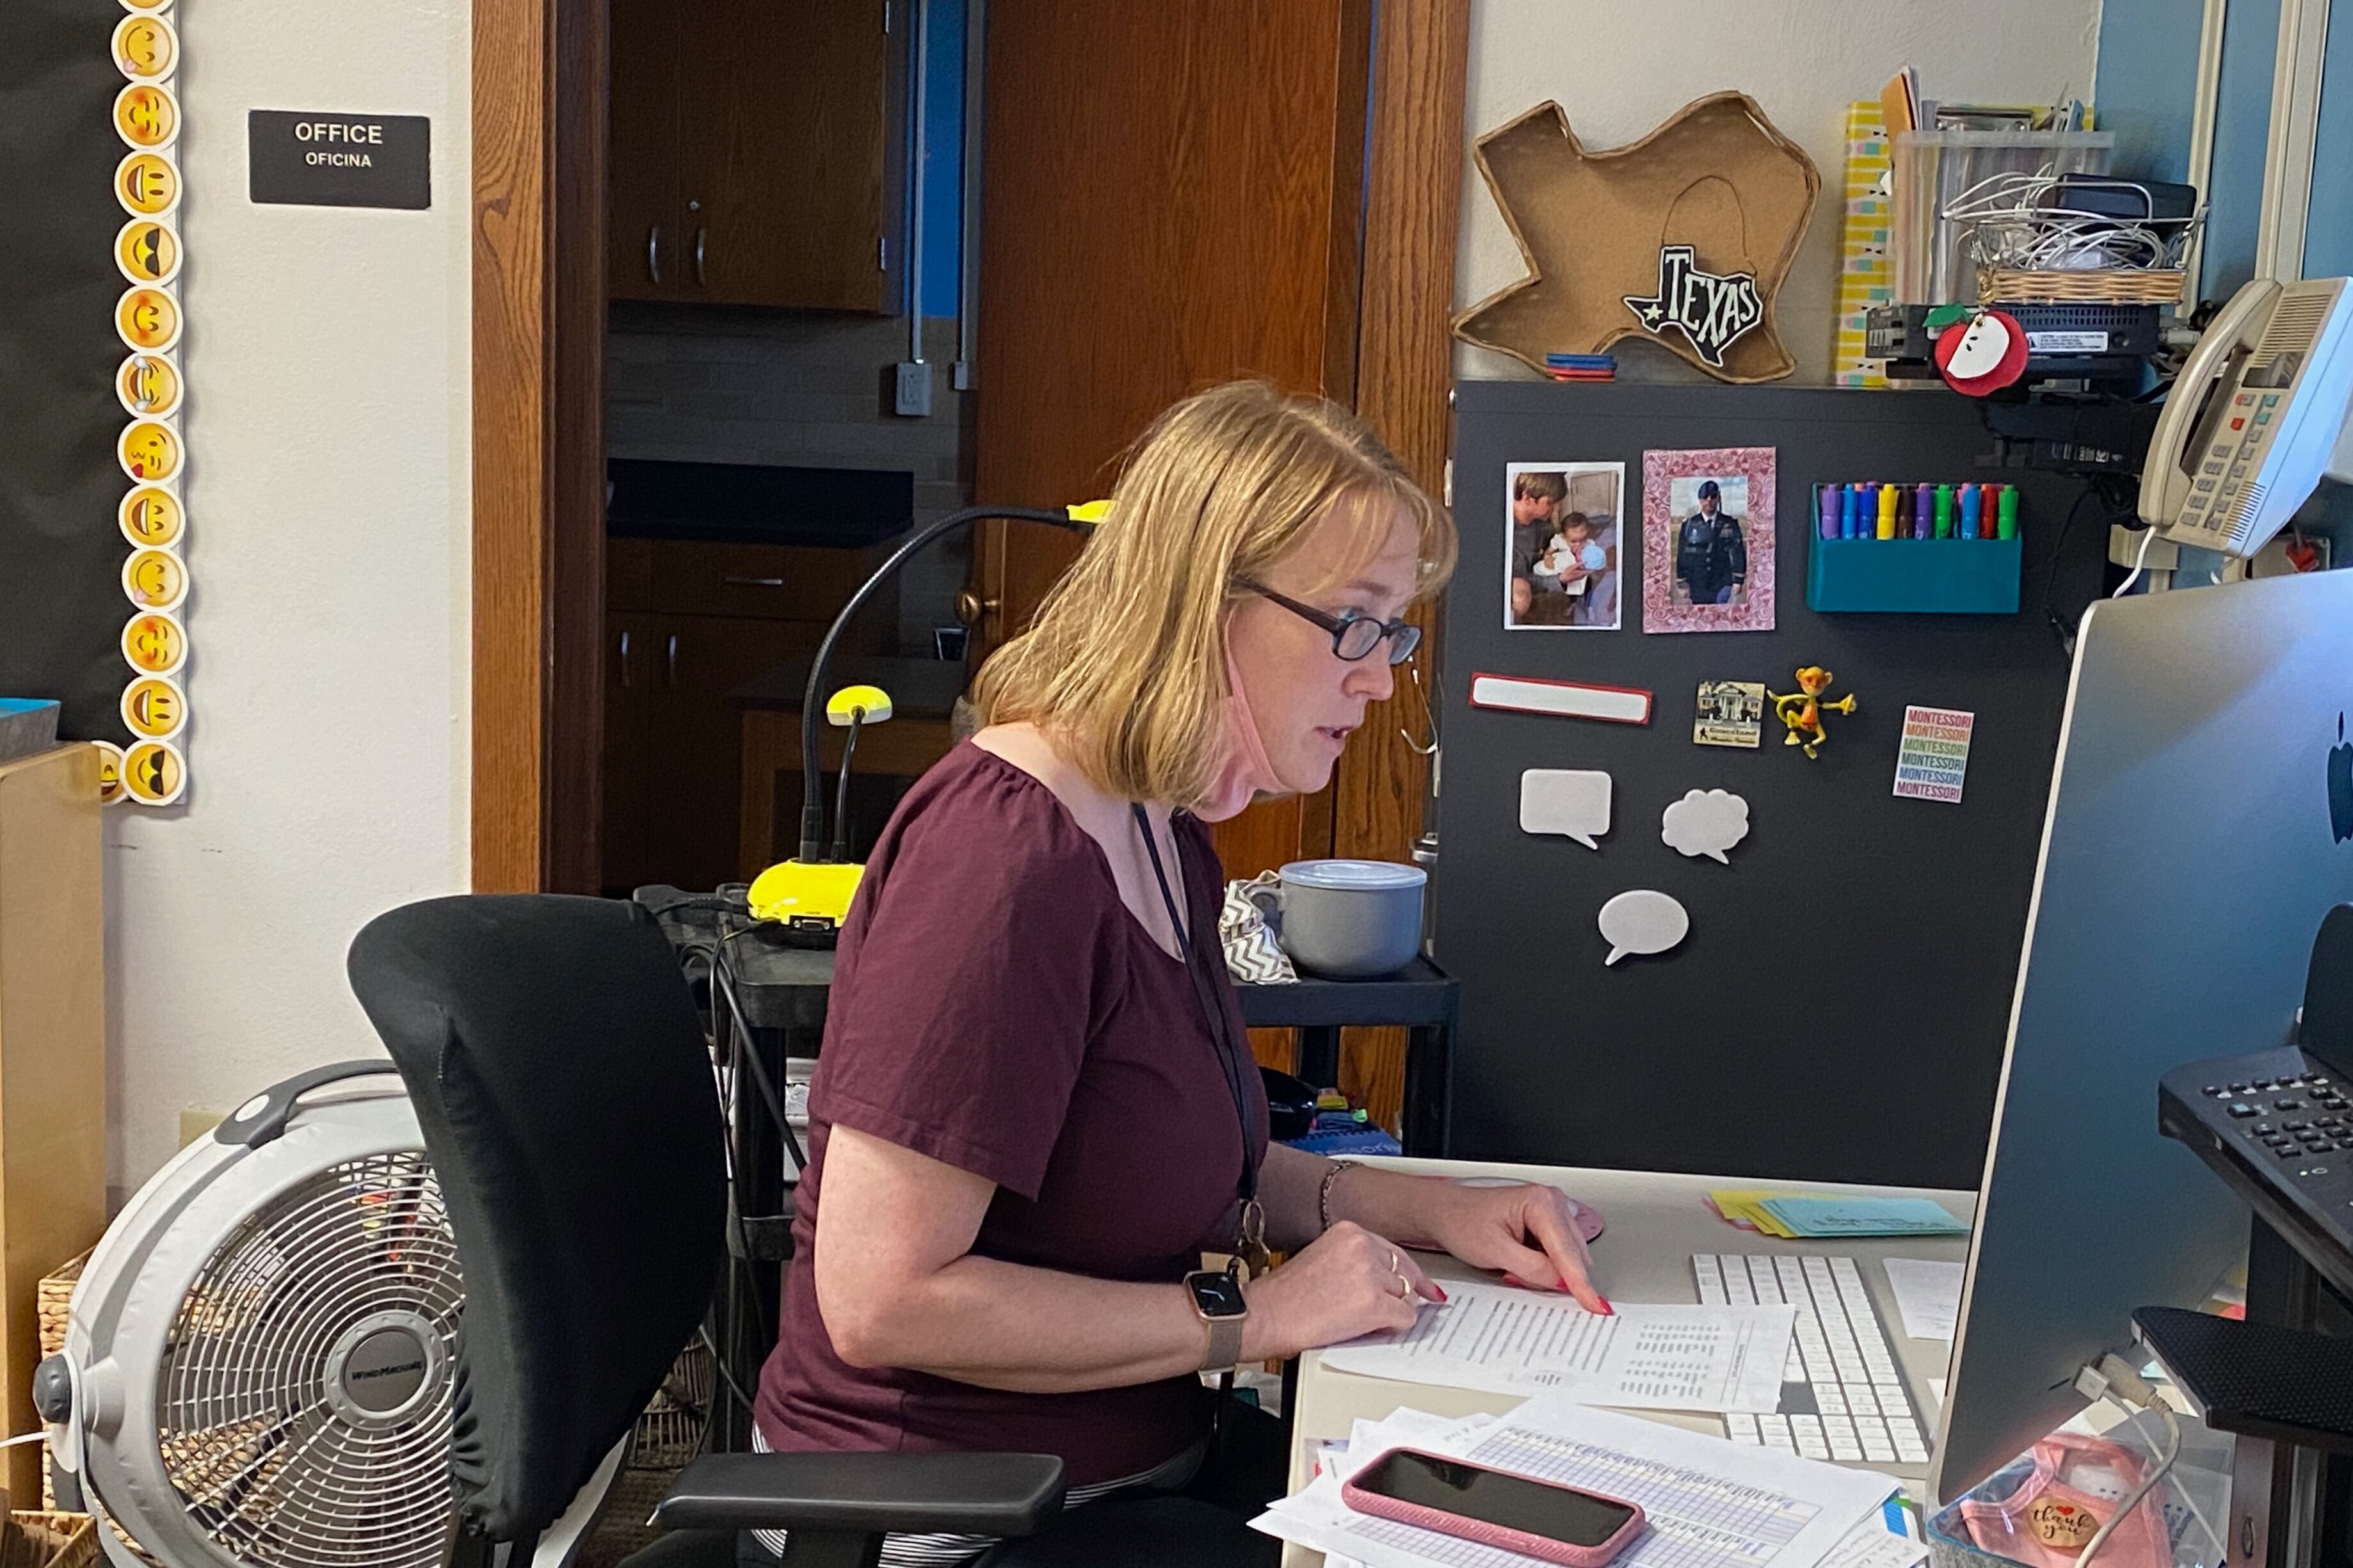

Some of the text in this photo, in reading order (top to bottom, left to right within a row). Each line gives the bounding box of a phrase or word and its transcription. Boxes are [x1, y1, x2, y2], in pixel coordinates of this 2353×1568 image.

[294, 122, 383, 145] OFFICE
[305, 151, 373, 168] OFICINA
[1664, 253, 1755, 348] TEXAS
[1907, 709, 1972, 728] MONTESSORI
[1905, 723, 1970, 742] MONTESSORI
[1903, 737, 1967, 756] MONTESSORI
[1900, 752, 1965, 771] MONTESSORI
[1899, 766, 1963, 786] MONTESSORI
[1896, 781, 1961, 800] MONTESSORI
[2030, 1505, 2091, 1528] thank
[2043, 1524, 2081, 1539] you
